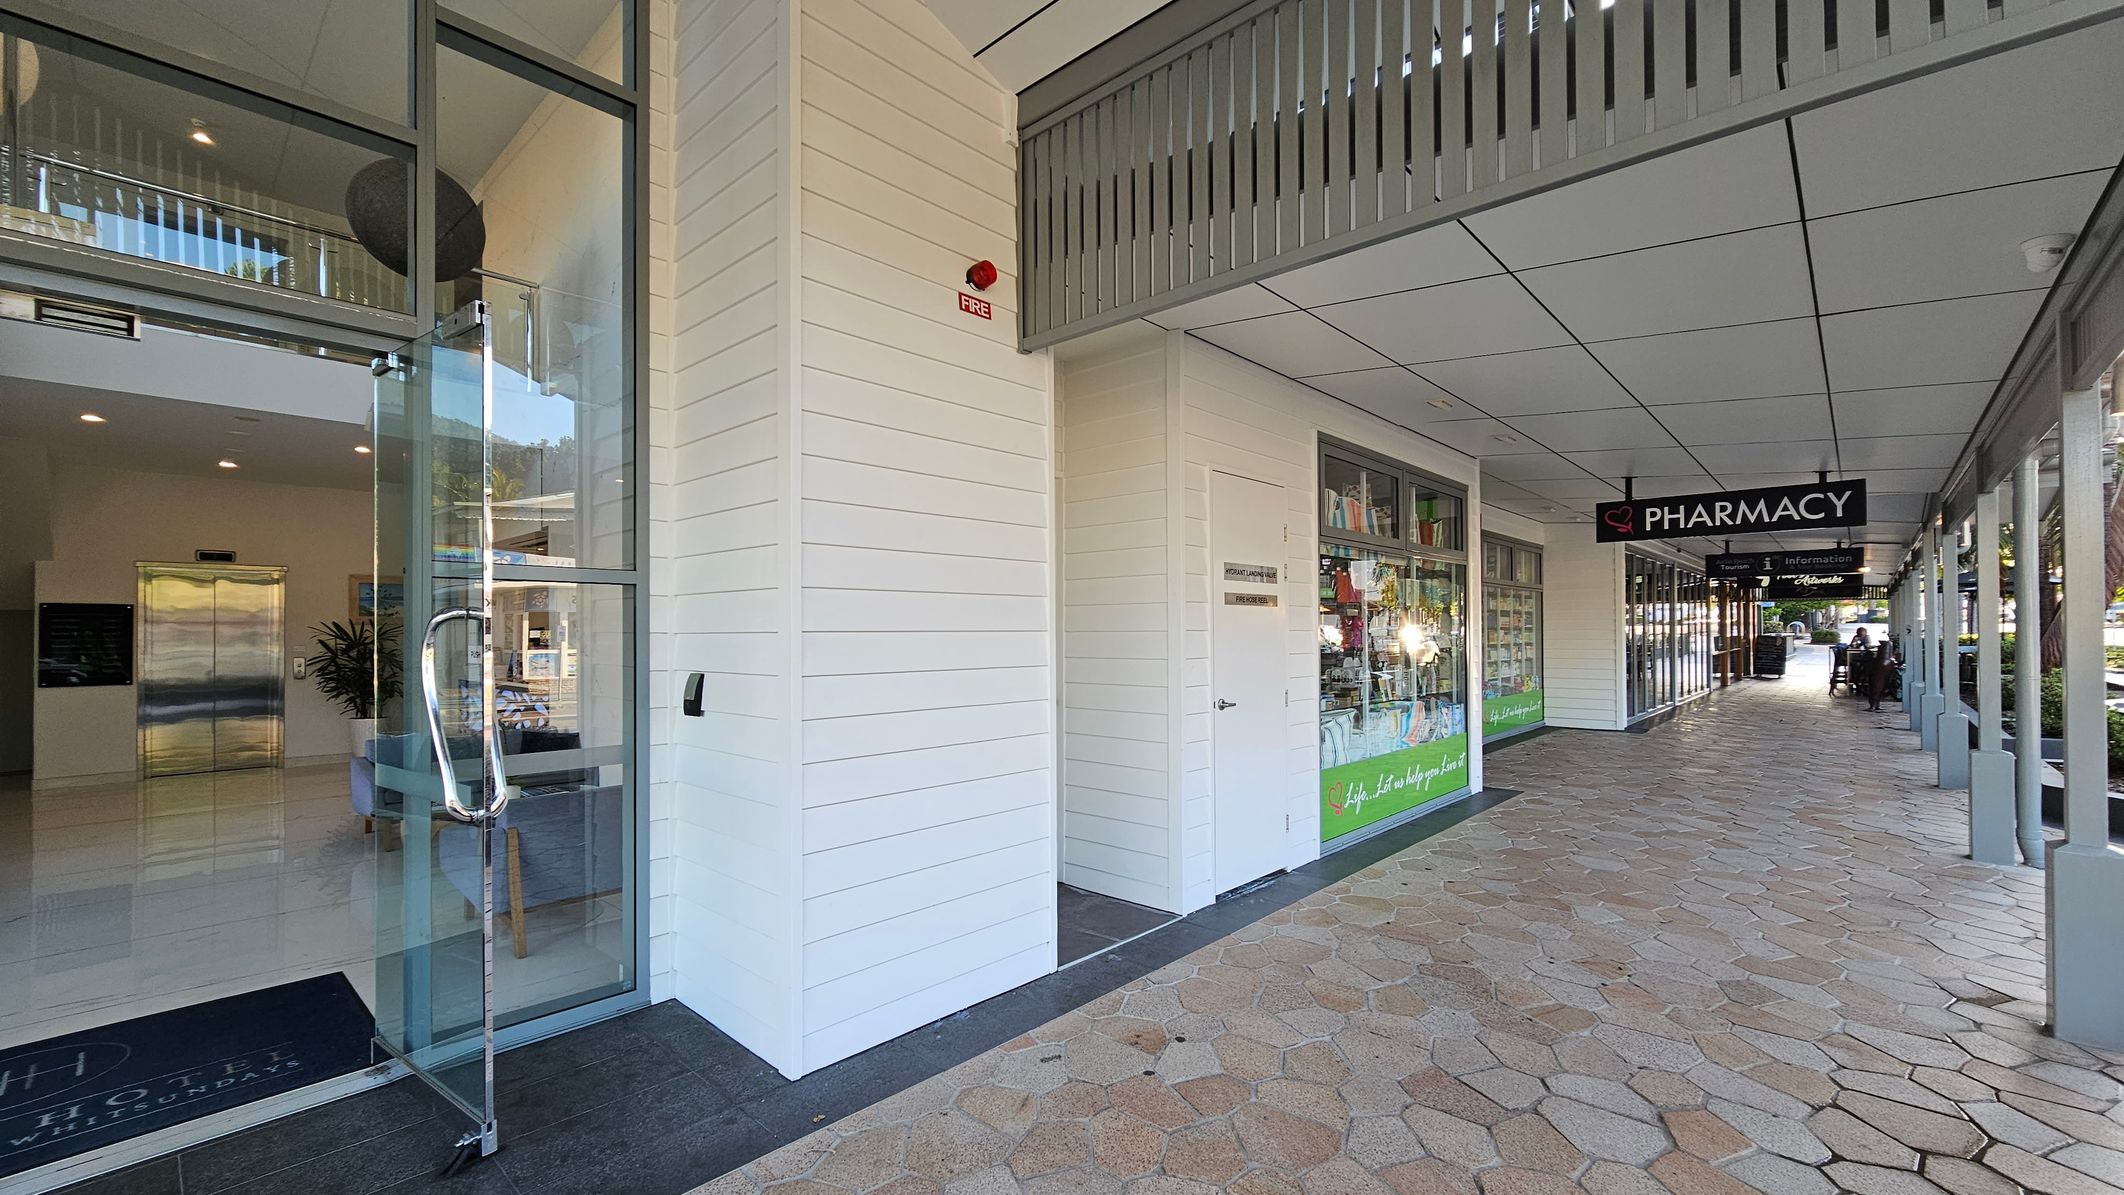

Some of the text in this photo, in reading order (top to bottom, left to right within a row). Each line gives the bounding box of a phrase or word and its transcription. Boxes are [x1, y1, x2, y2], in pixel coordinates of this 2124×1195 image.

[961, 295, 990, 318] FIRE
[1645, 490, 1852, 531] PHARMACY
[1225, 567, 1246, 576] HYDRANT
[1246, 570, 1264, 578] LANDING
[1785, 554, 1852, 565] Information
[1235, 595, 1246, 603] FIRE
[1246, 596, 1258, 604] HOSE
[1394, 779, 1405, 789] us
[1405, 764, 1424, 790] help
[1424, 767, 1440, 791] you
[1440, 754, 1458, 776] Live
[1458, 752, 1466, 768] it
[10, 1060, 300, 1146] WHITSUNDAYS
[36, 1050, 296, 1129] HOTEL
